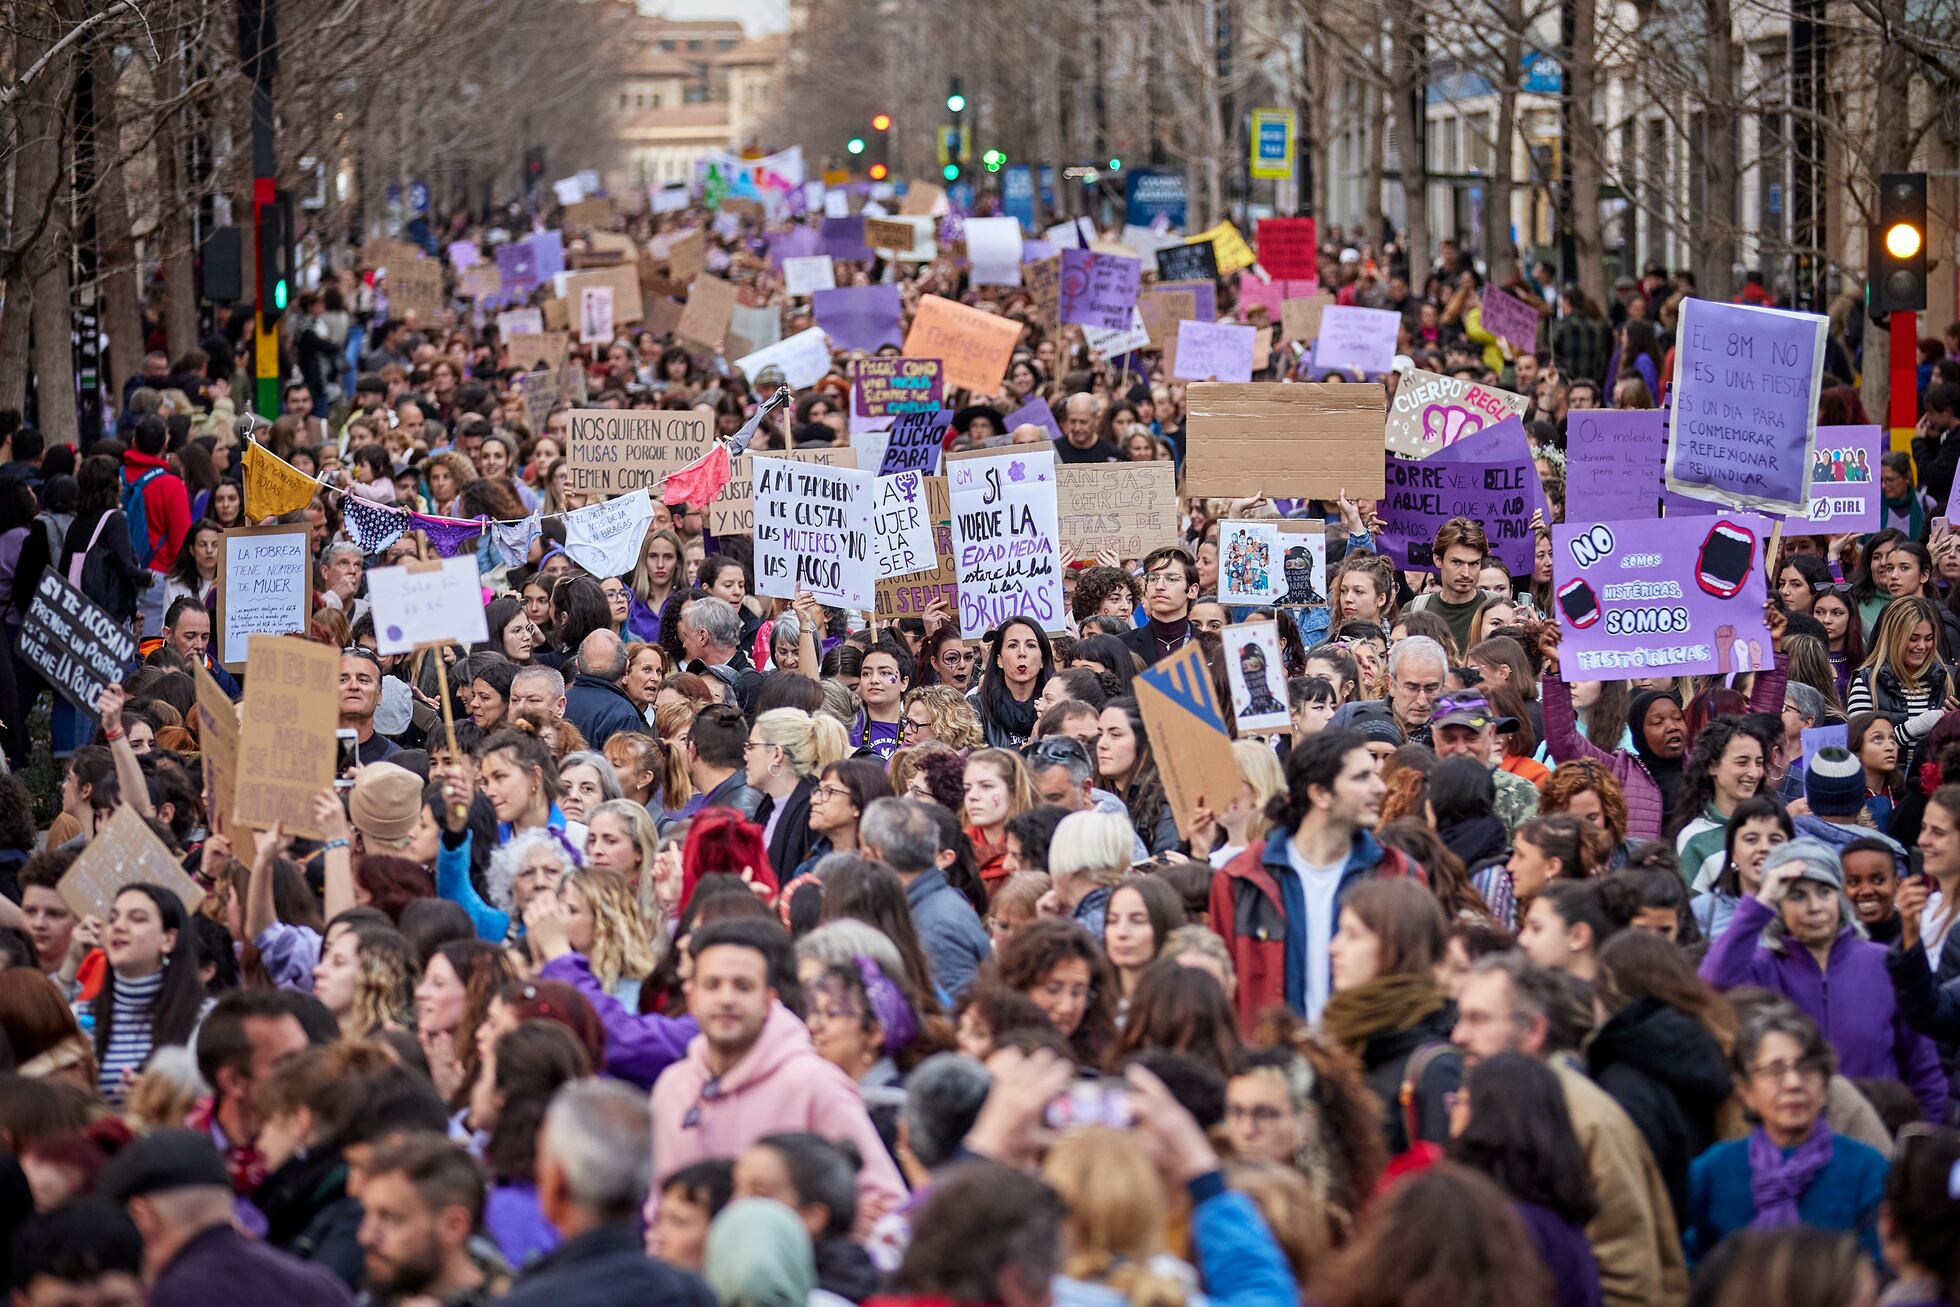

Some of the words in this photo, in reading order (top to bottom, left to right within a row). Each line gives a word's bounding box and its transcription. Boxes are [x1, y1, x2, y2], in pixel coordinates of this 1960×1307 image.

[1693, 324, 1712, 351] EL
[1726, 333, 1753, 359] 8M
[1772, 341, 1798, 367] NO
[1403, 374, 1417, 387] MI
[1695, 361, 1715, 383] ES
[1725, 370, 1754, 391] UNA
[1762, 373, 1810, 399] FIESTA
[1395, 378, 1463, 413] CUERPO
[1464, 386, 1516, 421] REGL
[1504, 394, 1519, 410] MIS
[903, 411, 939, 427] HOY
[1678, 392, 1693, 411] ES
[1702, 400, 1718, 415] UN
[1753, 408, 1785, 428] PARA
[572, 416, 604, 441] NOS
[607, 418, 661, 441] QUIEREN
[667, 420, 705, 442] COMO
[889, 425, 947, 447] LUCHO
[1580, 419, 1605, 443] Os
[1613, 430, 1653, 444] molesta
[573, 444, 617, 463] MUSAS
[626, 445, 668, 460] PORQUE
[675, 446, 700, 461] NOS
[814, 453, 834, 466] ME
[884, 448, 929, 468] PARA
[570, 468, 610, 489] TEMEN
[618, 468, 654, 489] COMO
[760, 469, 771, 494] A
[775, 468, 794, 493] MÍ
[798, 477, 854, 502] TAMBIÉN
[957, 468, 973, 485] 8M
[983, 467, 1002, 504] SI
[1448, 474, 1465, 488] VE
[1472, 476, 1479, 489] Y
[1484, 466, 1527, 490] DILE
[883, 482, 900, 506] A
[1393, 492, 1448, 515] AQUEL
[1452, 501, 1479, 516] QUE
[1485, 502, 1499, 516] YA
[1503, 496, 1525, 515] NO
[1834, 499, 1862, 513] GIRL
[576, 514, 586, 523] EL
[588, 519, 605, 530] NOS
[607, 510, 626, 524] DEJA
[716, 511, 727, 532] Y
[733, 510, 754, 530] NO
[770, 501, 787, 518] ME
[795, 502, 847, 529] GUSTAN
[873, 506, 920, 536] UJER
[957, 509, 1002, 543] VUELVE
[1010, 503, 1037, 538] LA
[1135, 511, 1161, 530] DE
[600, 518, 633, 538] BRAGAS
[1494, 519, 1528, 539] TAN
[238, 548, 250, 560] LA
[255, 545, 301, 558] POBREZA
[759, 524, 780, 541] LAS
[783, 527, 837, 554] MUJERES
[839, 533, 849, 552] Y
[848, 530, 867, 562] NO
[887, 532, 909, 551] LA
[961, 543, 1006, 567] EDAD
[1009, 537, 1052, 559] MEDIA
[1570, 524, 1614, 569] NO
[233, 565, 261, 577] TIENE
[267, 564, 304, 576] NOMBRE
[764, 554, 788, 578] LAS
[796, 554, 841, 590] ACOSO
[880, 550, 916, 575] SER
[962, 564, 1004, 583] estaré
[1005, 560, 1028, 577] del
[1026, 556, 1052, 578] lado
[1620, 553, 1662, 568] SOMOS
[238, 582, 250, 591] DE
[253, 578, 291, 593] MUJER
[988, 582, 998, 594] de
[1001, 580, 1023, 593] las
[1602, 580, 1682, 600] HISTÉRICAS,
[897, 583, 959, 613] SENT
[960, 585, 1053, 631] BRUJAS
[40, 576, 62, 601] SI
[61, 590, 81, 615] TE
[79, 605, 135, 661] ACOSAN
[1605, 606, 1688, 635] SOMOS
[30, 597, 72, 643] PRENDE
[70, 634, 86, 655] UN
[84, 642, 124, 683] PORRO
[1577, 644, 1711, 670] HISTÓRICAS
[21, 632, 58, 675] VIENE
[55, 653, 72, 684] LA
[69, 665, 104, 711] POLIC
